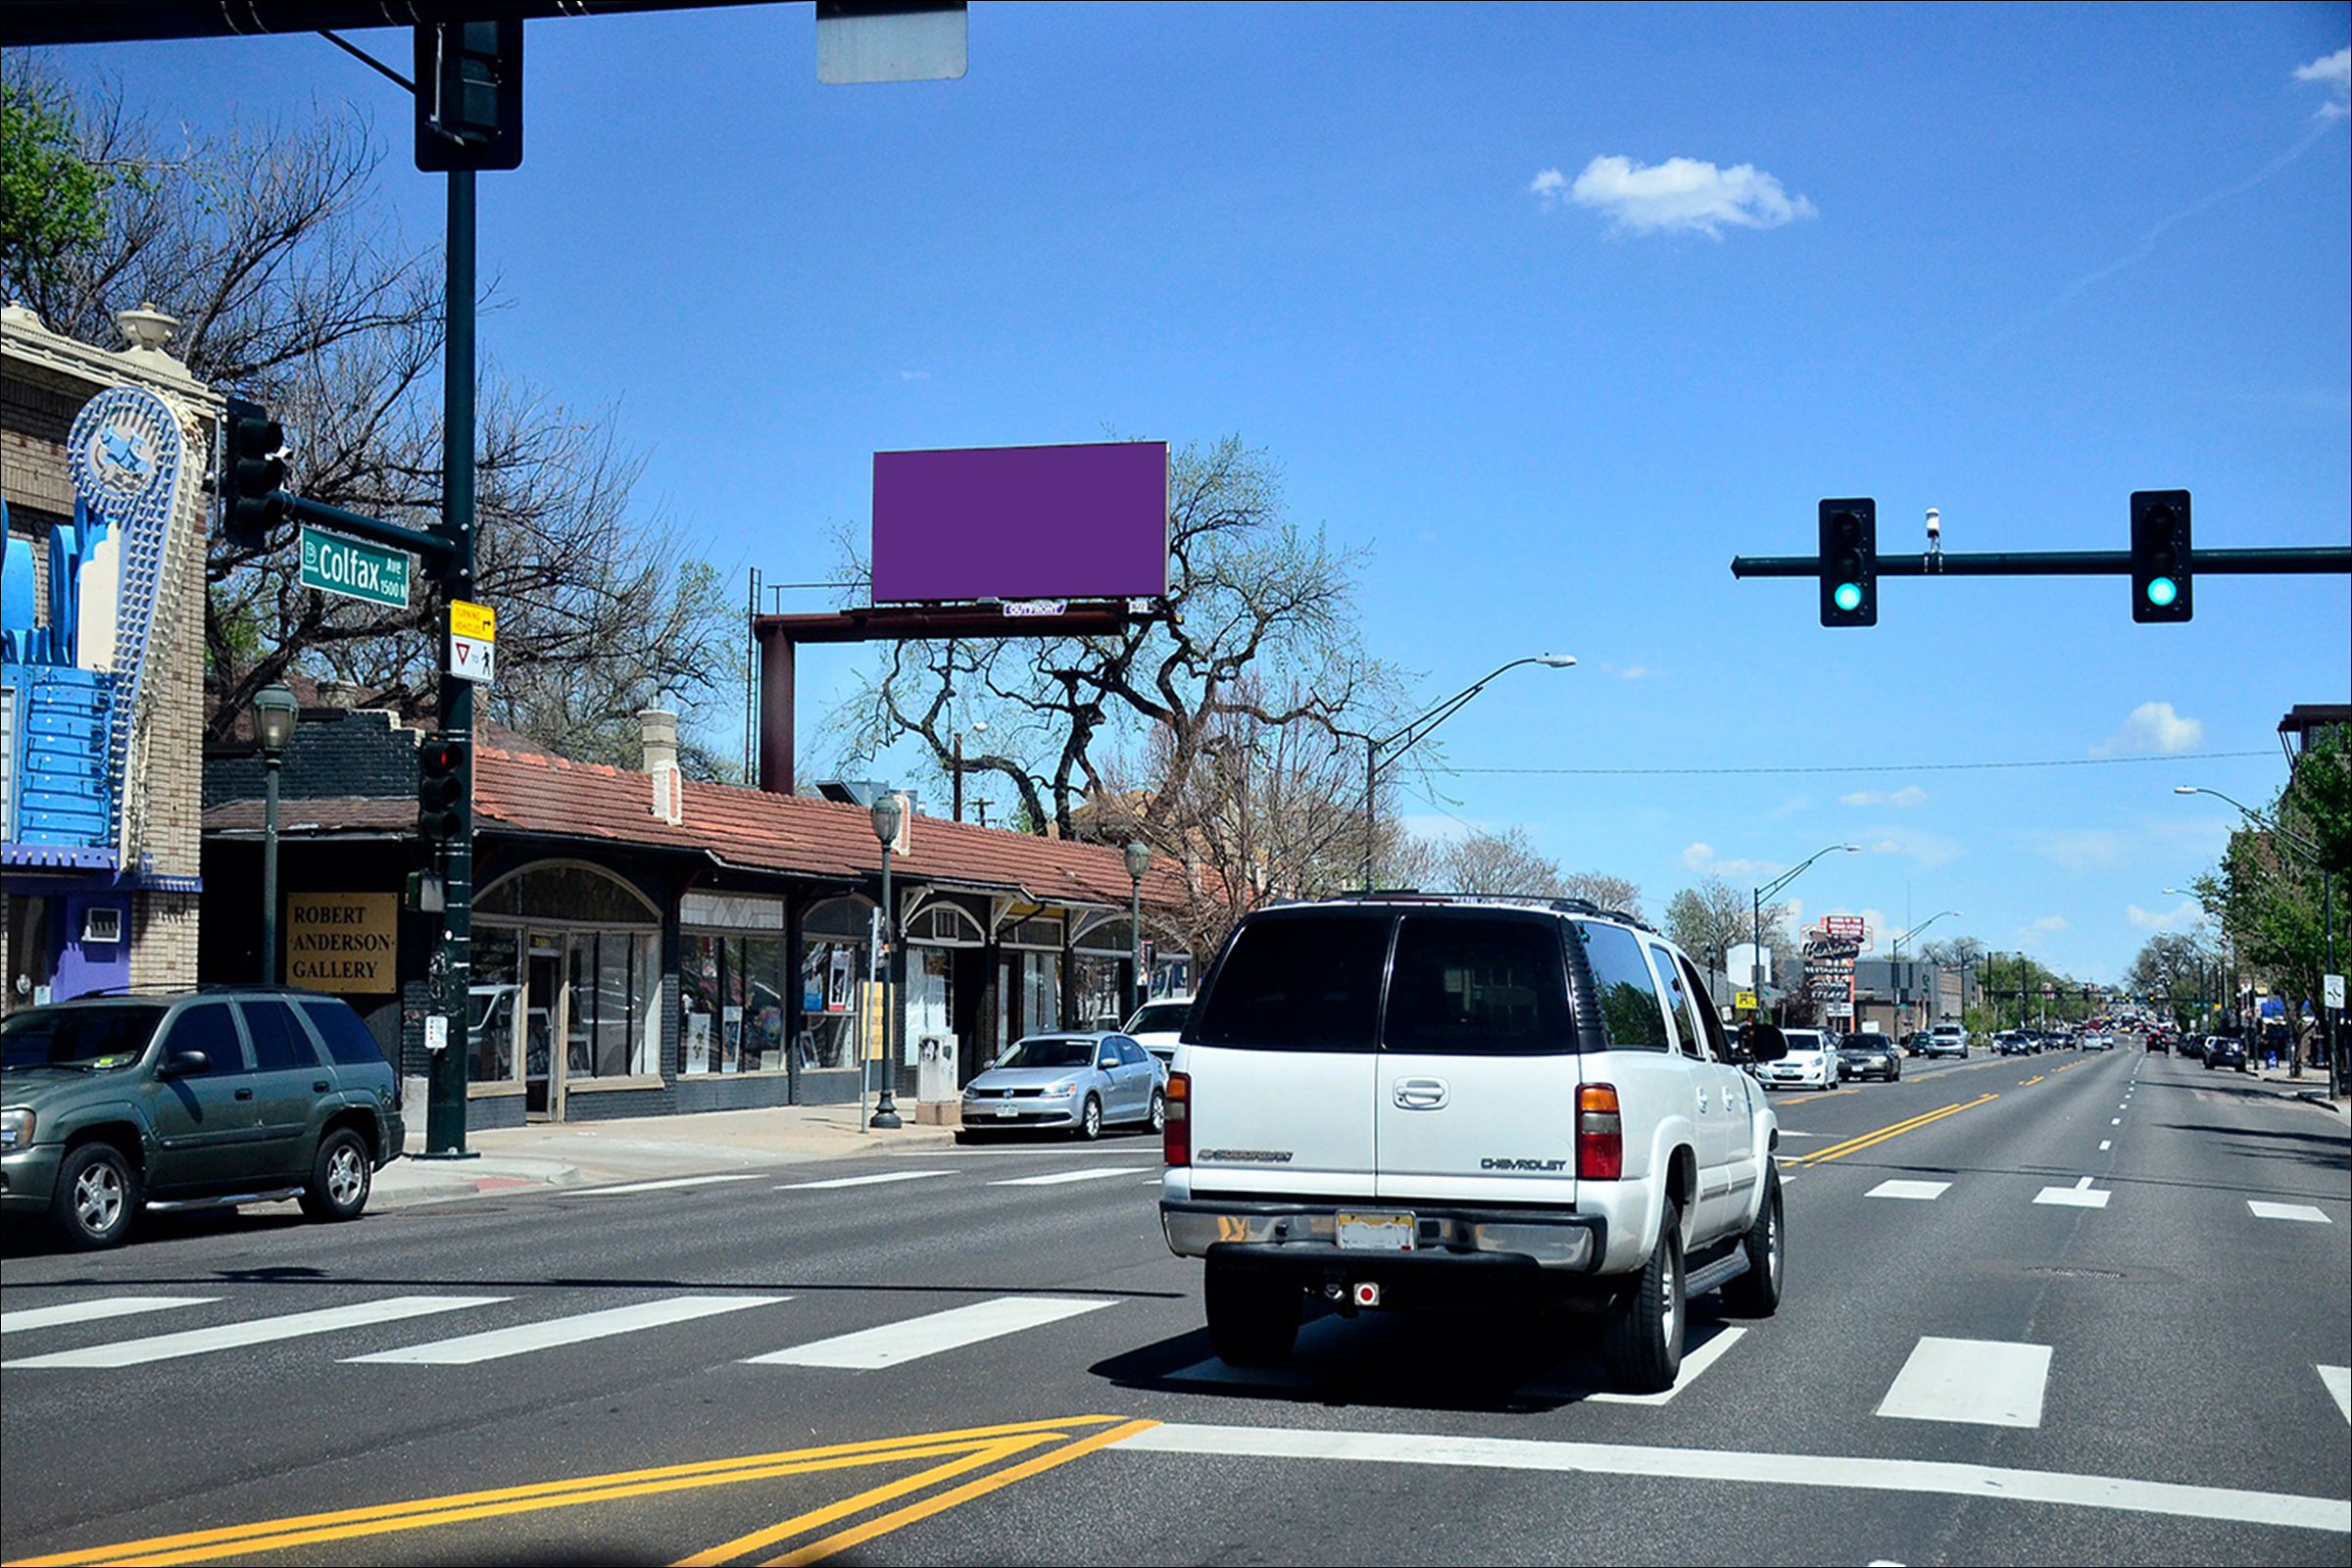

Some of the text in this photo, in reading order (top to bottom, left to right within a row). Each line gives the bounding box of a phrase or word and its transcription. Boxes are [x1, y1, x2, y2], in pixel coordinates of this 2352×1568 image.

[319, 544, 379, 591] Colfax
[385, 558, 402, 574] Ave
[380, 579, 399, 597] 1500
[294, 906, 367, 924] ROBERT
[293, 933, 391, 952] ANDERSON
[292, 960, 378, 979] GALLERY
[1481, 1158, 1567, 1171] CHEVROLET
